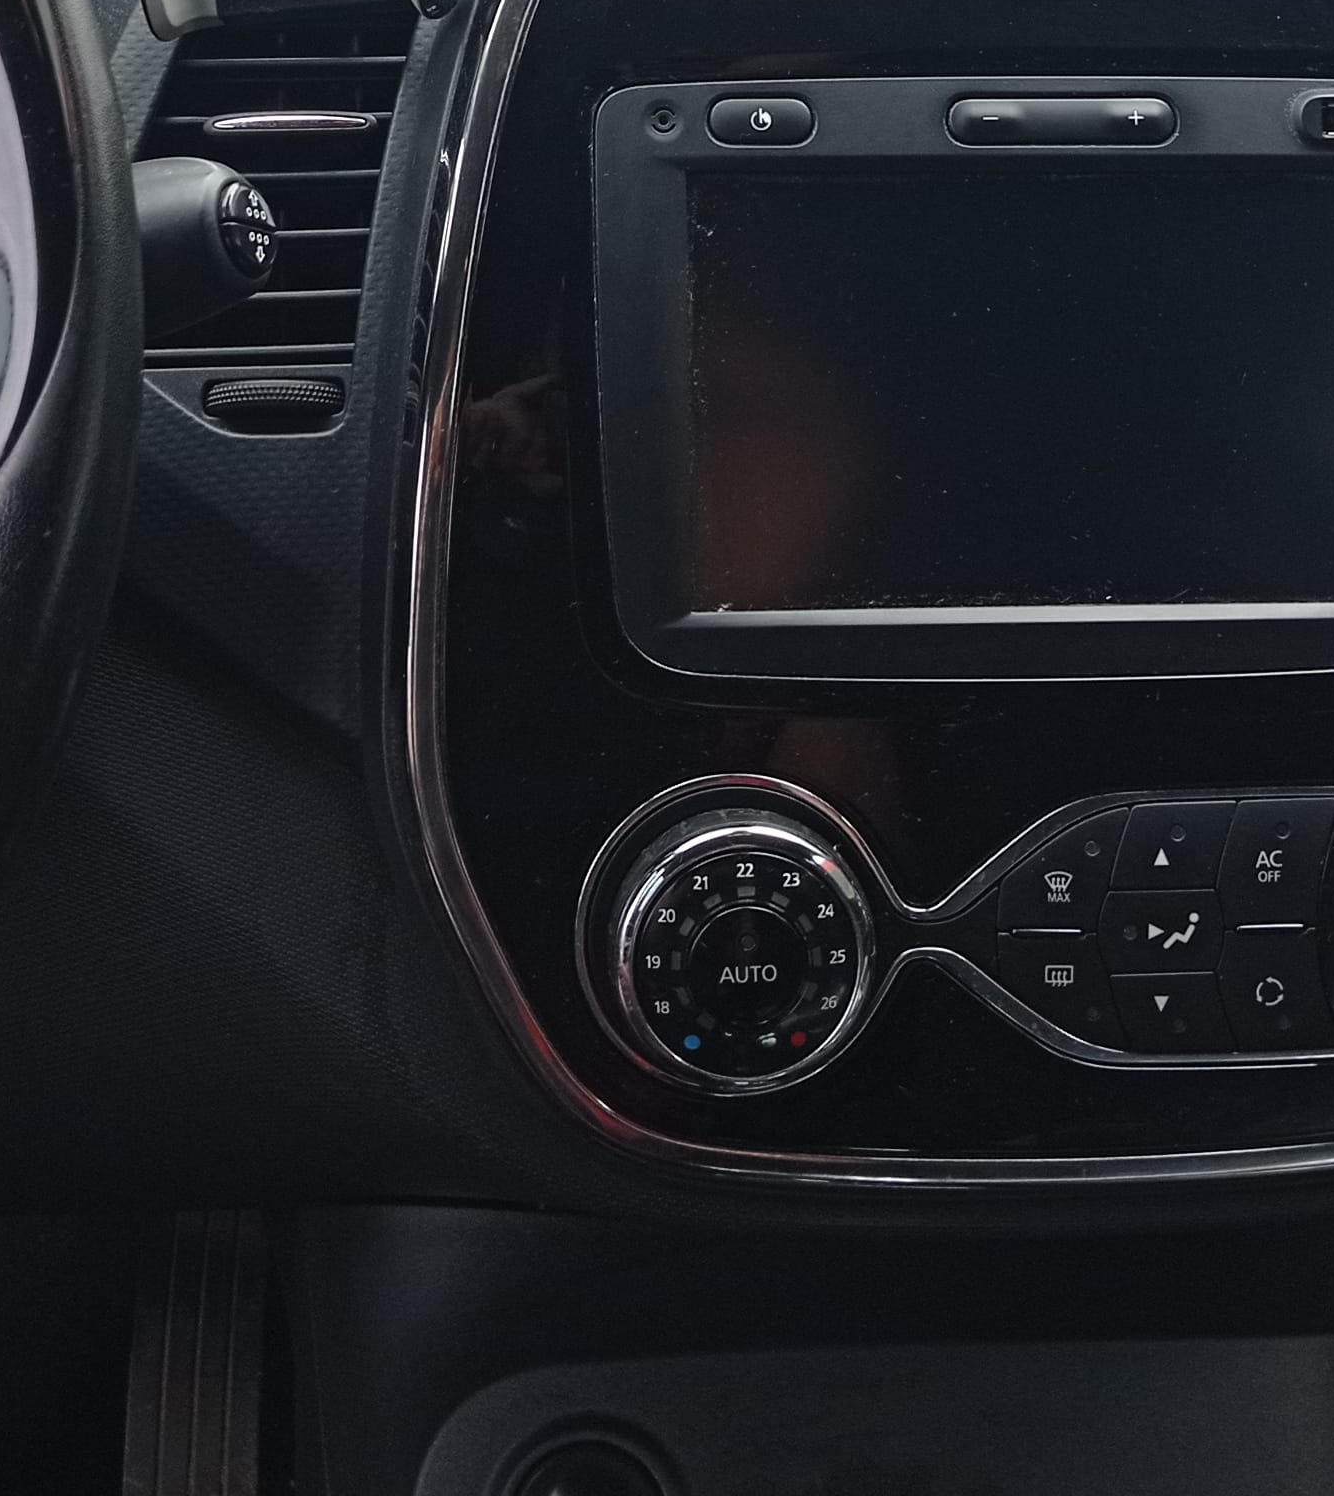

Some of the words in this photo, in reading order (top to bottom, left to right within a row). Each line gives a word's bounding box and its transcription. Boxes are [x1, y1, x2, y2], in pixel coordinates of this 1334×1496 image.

[1255, 849, 1283, 869] AC
[736, 863, 755, 878] 22
[1257, 870, 1282, 883] OFF
[692, 875, 709, 891] 21
[782, 872, 801, 888] 23
[1047, 892, 1072, 903] MAX
[657, 908, 676, 924] 20
[817, 903, 835, 919] 24
[645, 955, 661, 970] 19
[829, 949, 846, 964] 25
[719, 964, 778, 984] AUTO
[654, 1000, 670, 1015] 18
[820, 995, 838, 1010] 26
